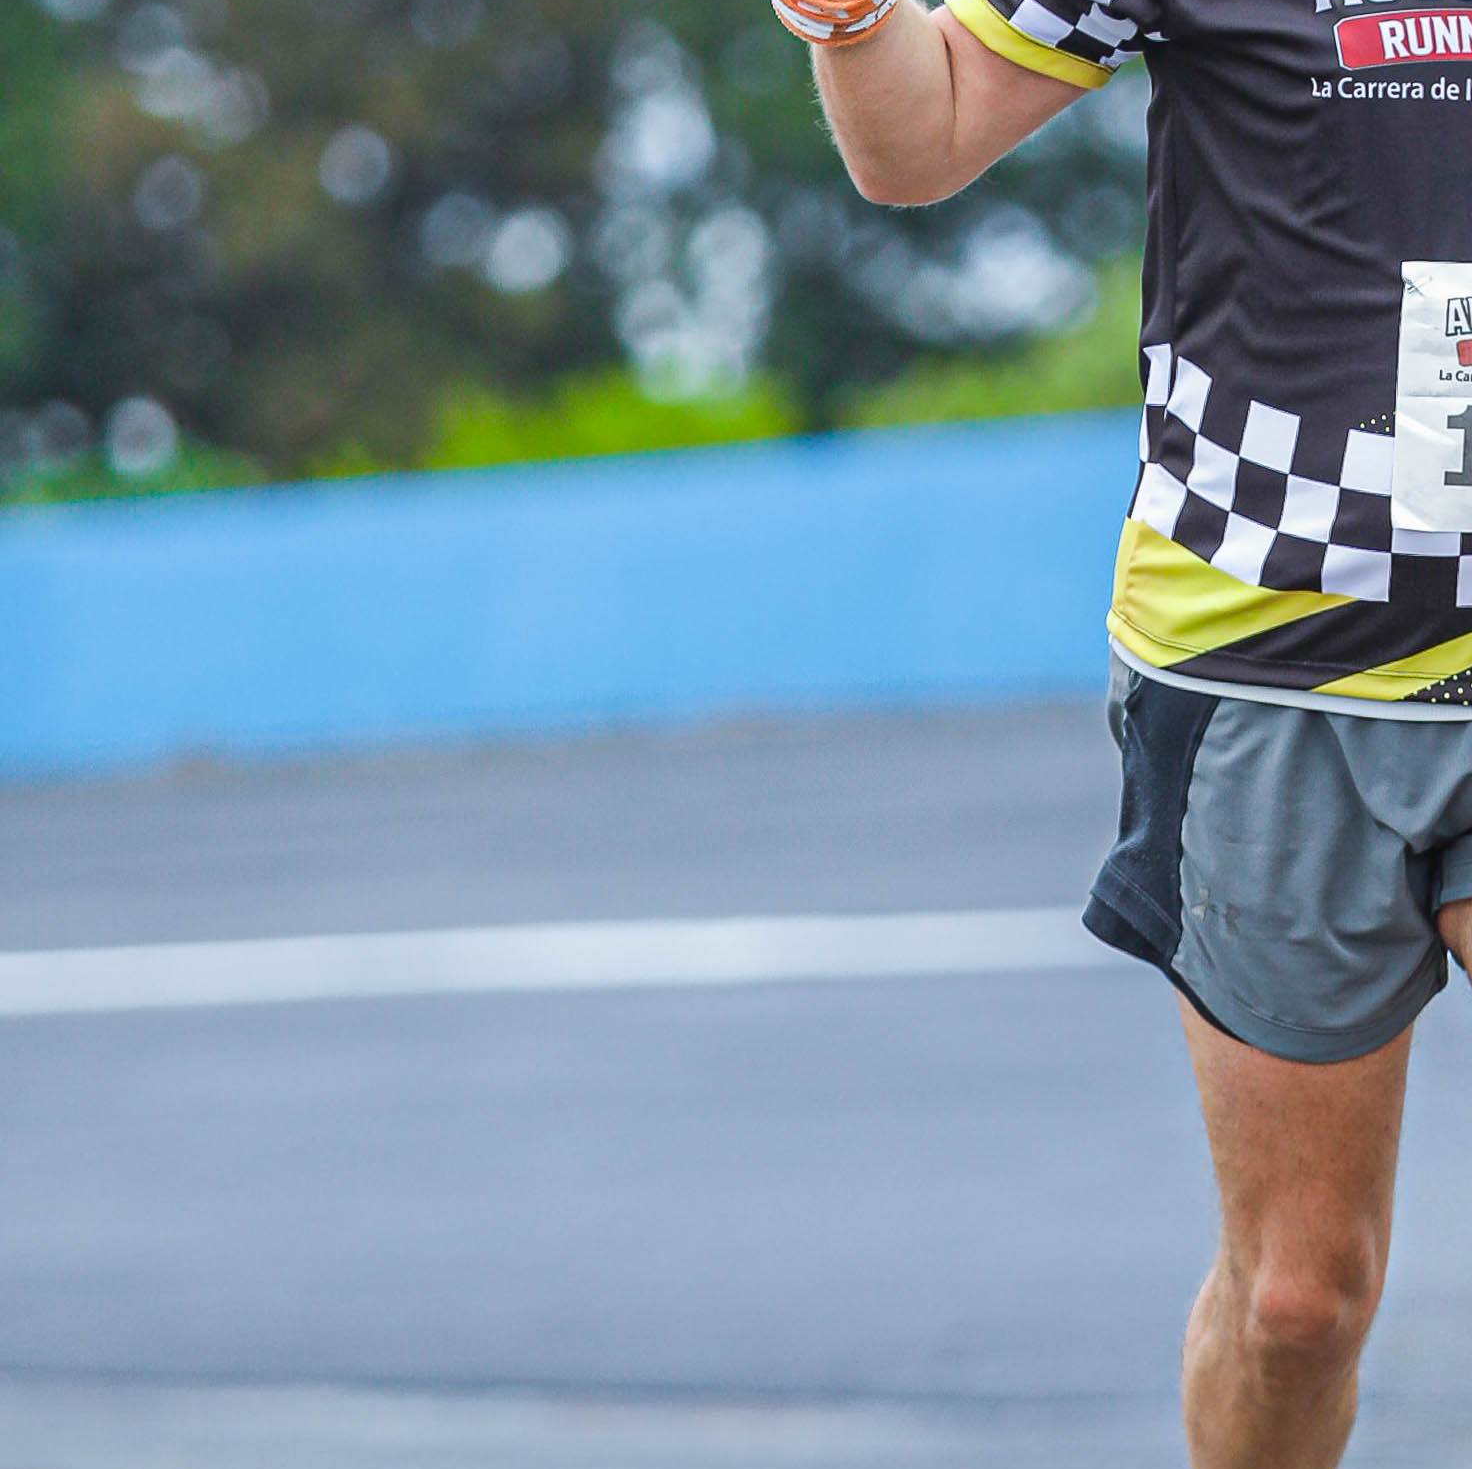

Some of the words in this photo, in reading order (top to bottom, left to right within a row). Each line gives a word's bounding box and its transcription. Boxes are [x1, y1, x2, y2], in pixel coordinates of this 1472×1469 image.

[1310, 77, 1332, 98] La
[1337, 77, 1425, 99] Carrera
[1430, 76, 1460, 100] de
[1439, 369, 1453, 381] La
